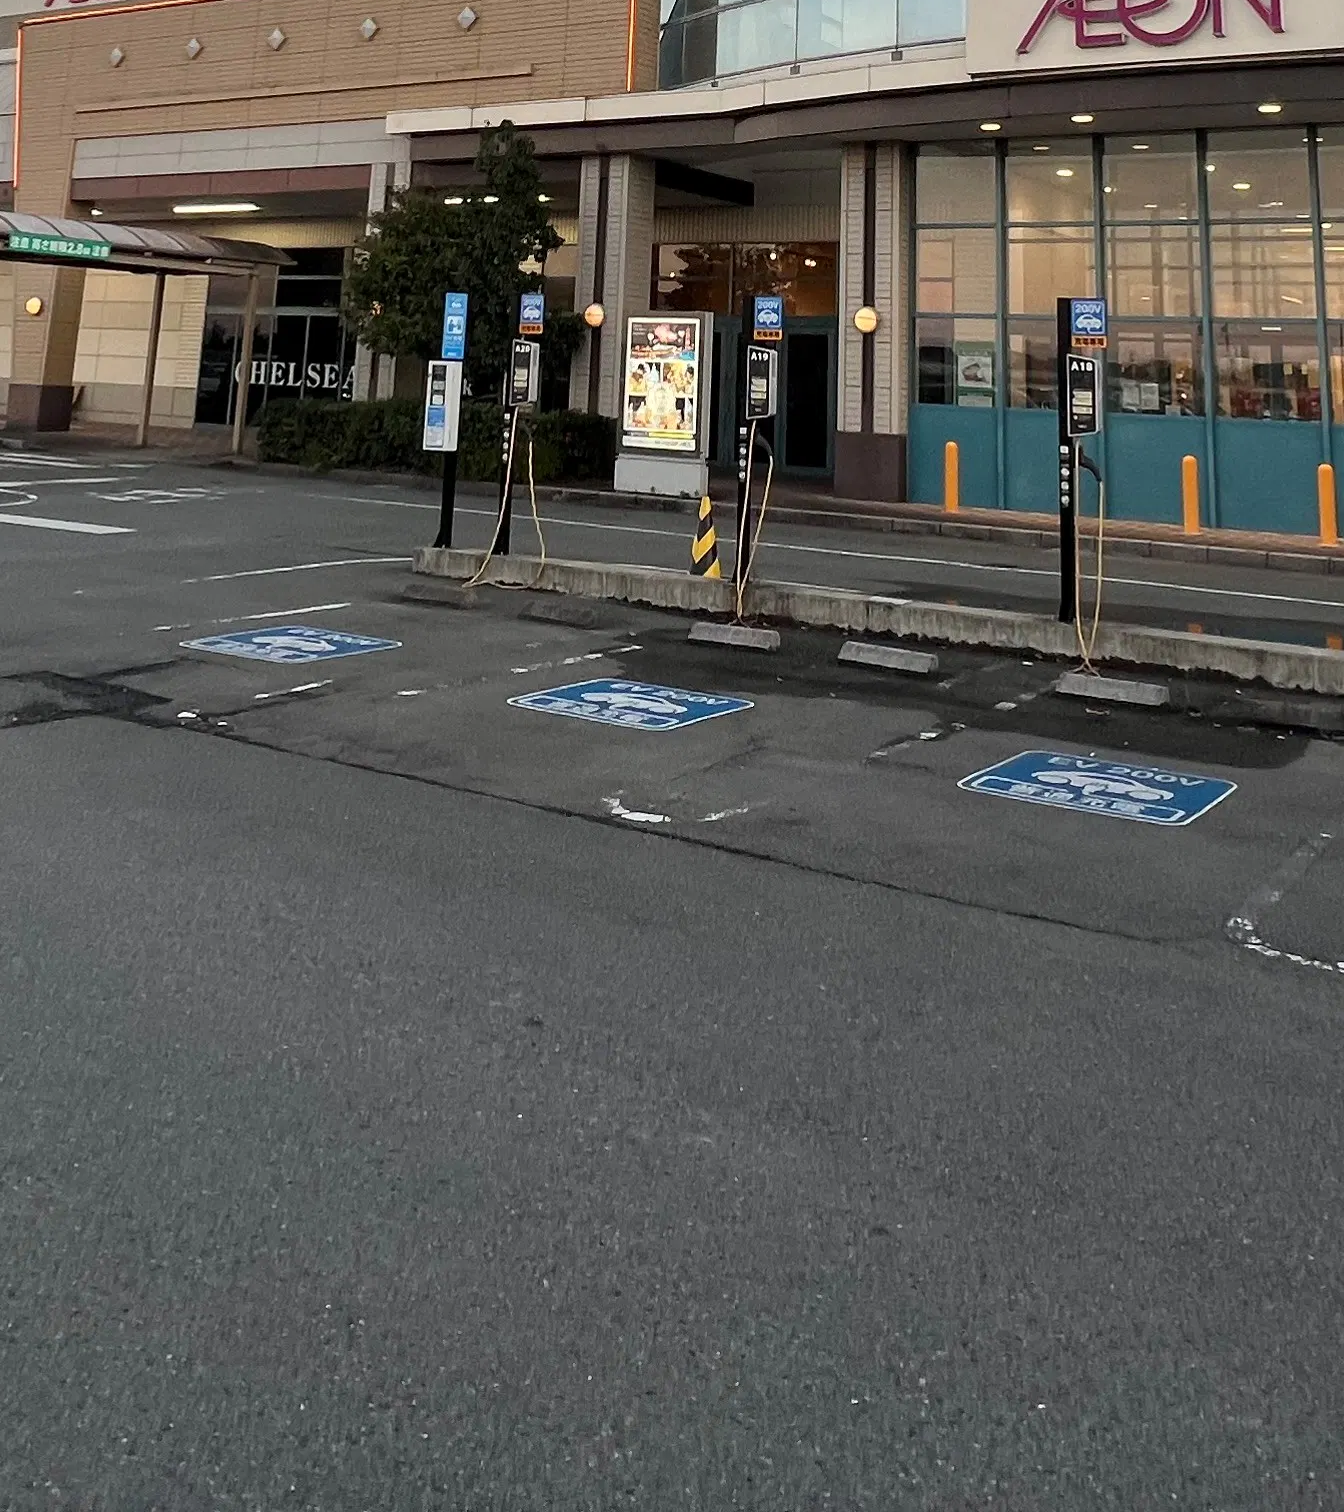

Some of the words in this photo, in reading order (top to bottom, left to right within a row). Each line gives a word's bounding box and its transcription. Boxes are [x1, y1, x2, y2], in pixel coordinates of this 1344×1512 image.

[1075, 304, 1102, 314] 200V
[750, 351, 769, 361] A19
[1105, 766, 1206, 787] 200V
